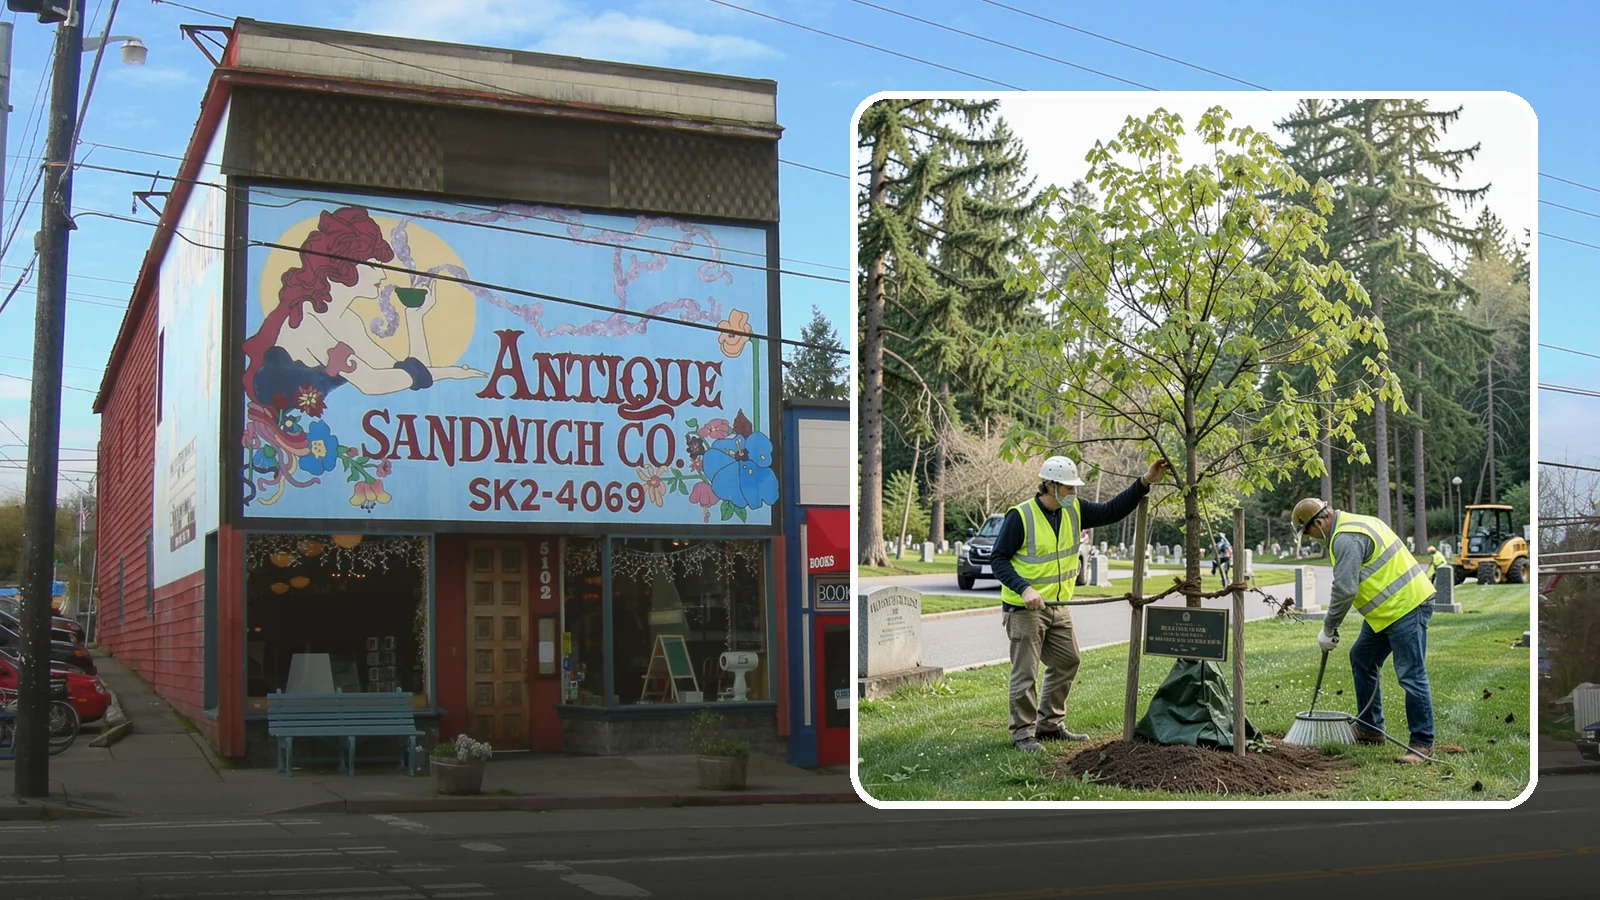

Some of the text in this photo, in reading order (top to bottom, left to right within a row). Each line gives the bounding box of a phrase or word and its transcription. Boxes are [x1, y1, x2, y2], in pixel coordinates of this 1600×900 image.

[476, 330, 724, 421] ANTIQUE
[361, 408, 685, 469] SANDWICH CO.
[468, 477, 646, 514] SK2-4069
[539, 541, 552, 600] 5102
[809, 555, 835, 569] BOOKS
